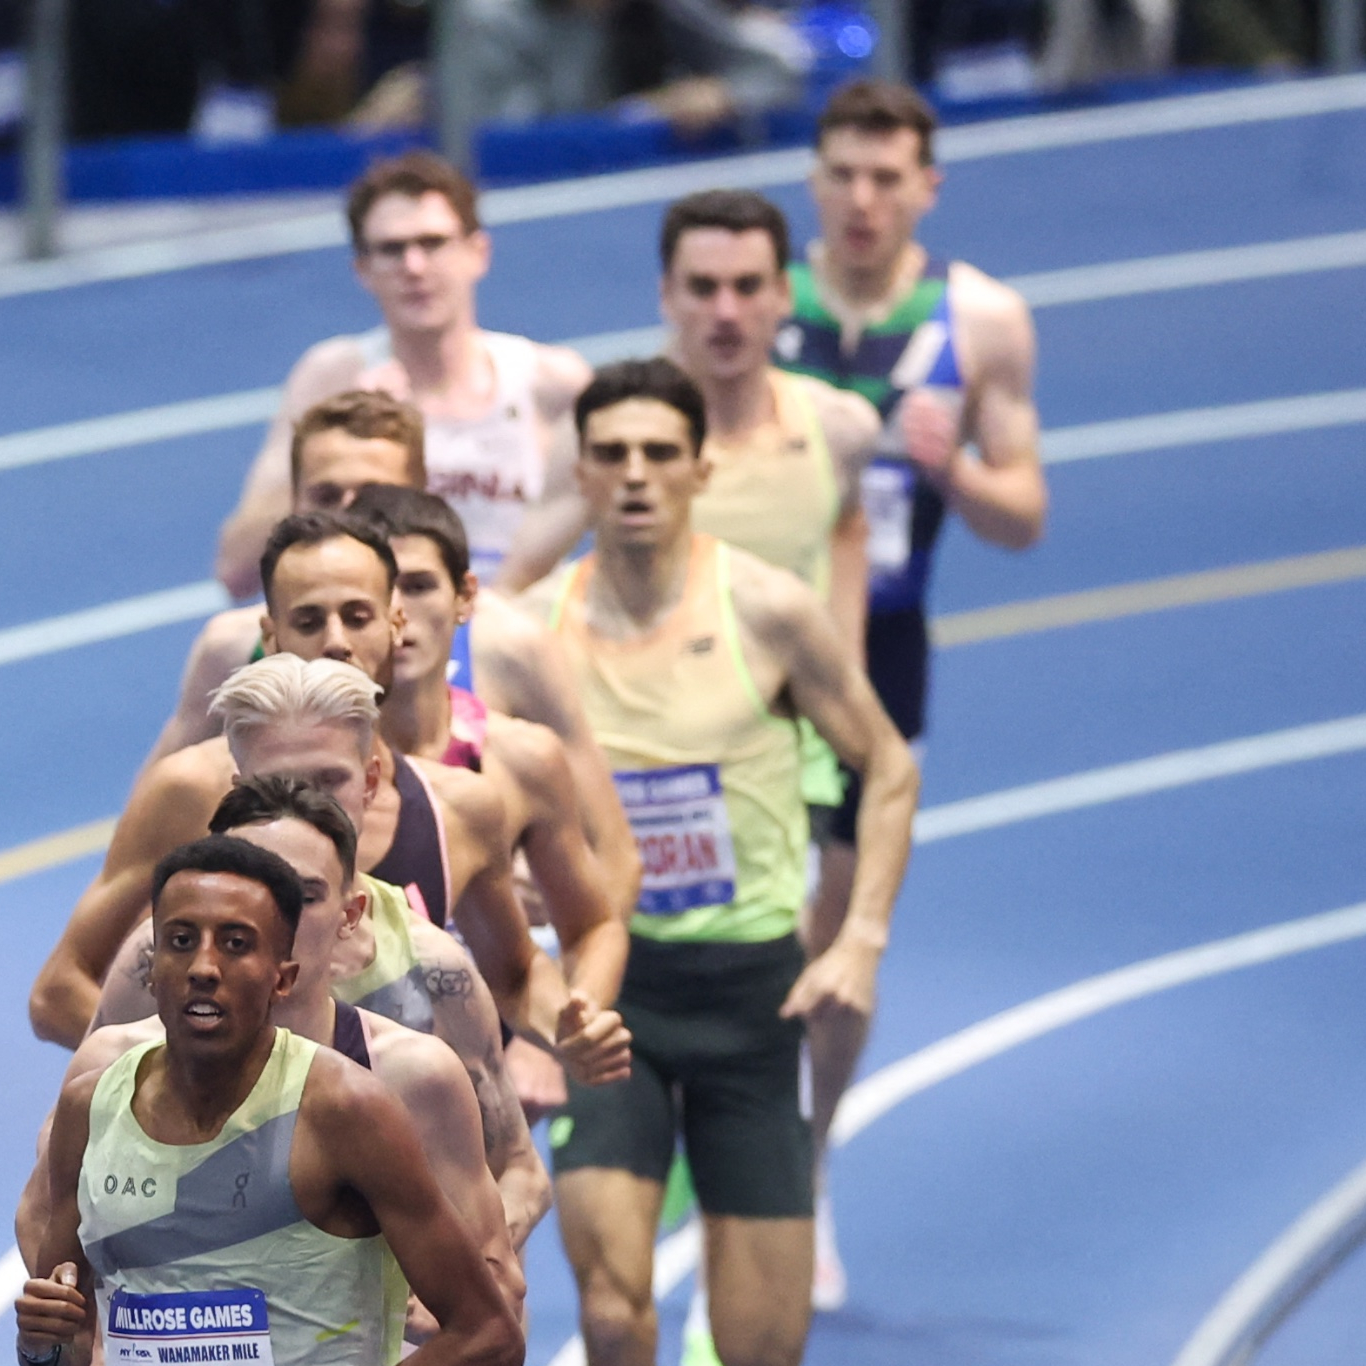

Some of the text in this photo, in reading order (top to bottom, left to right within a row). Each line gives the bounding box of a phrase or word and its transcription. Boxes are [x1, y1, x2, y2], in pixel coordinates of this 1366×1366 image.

[104, 1174, 157, 1198] OAC
[115, 1304, 253, 1331] MILLROSE GAMES
[157, 1344, 229, 1363] WANAMAKER
[233, 1343, 260, 1361] MILE
